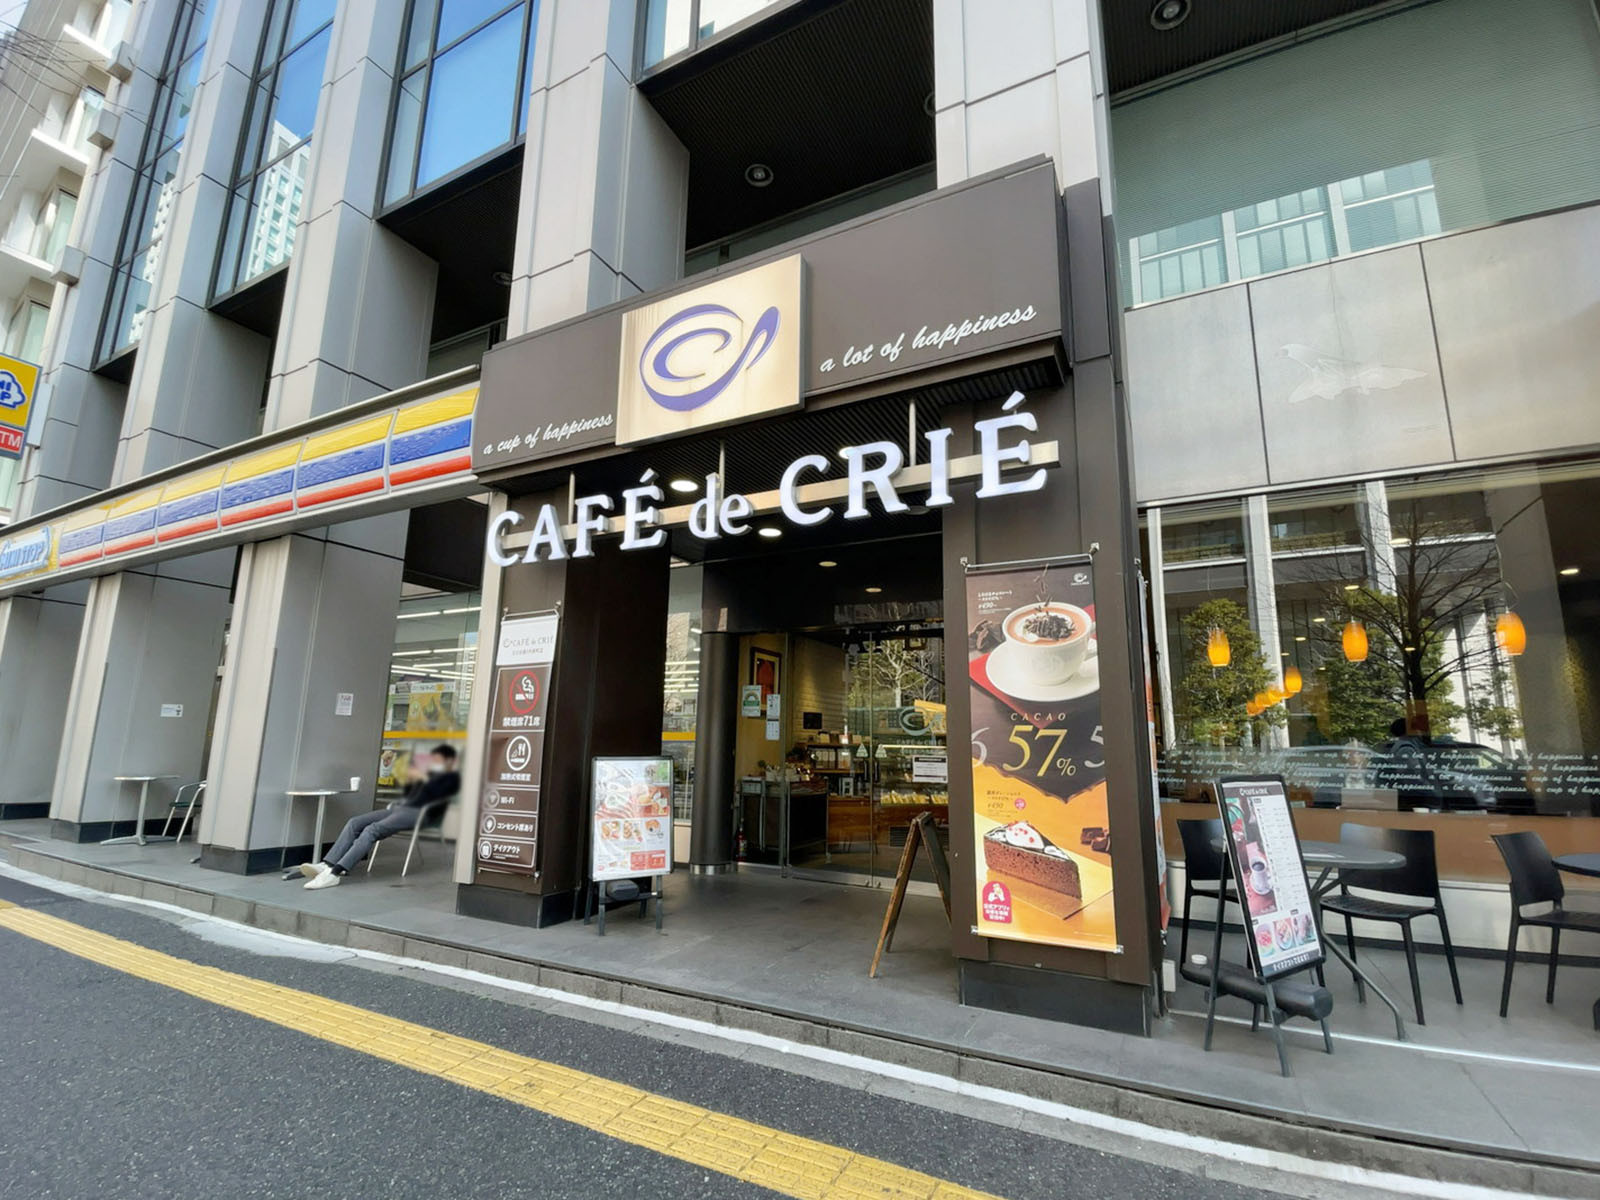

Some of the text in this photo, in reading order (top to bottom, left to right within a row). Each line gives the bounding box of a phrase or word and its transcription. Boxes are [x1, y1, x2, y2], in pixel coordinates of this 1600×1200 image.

[819, 305, 1038, 373] a lot of happiness
[483, 414, 613, 455] a cup of happiness
[487, 390, 1049, 568] CAFÉ de CRIÉ
[1010, 712, 1067, 721] CACAO
[1003, 724, 1077, 777] 57%
